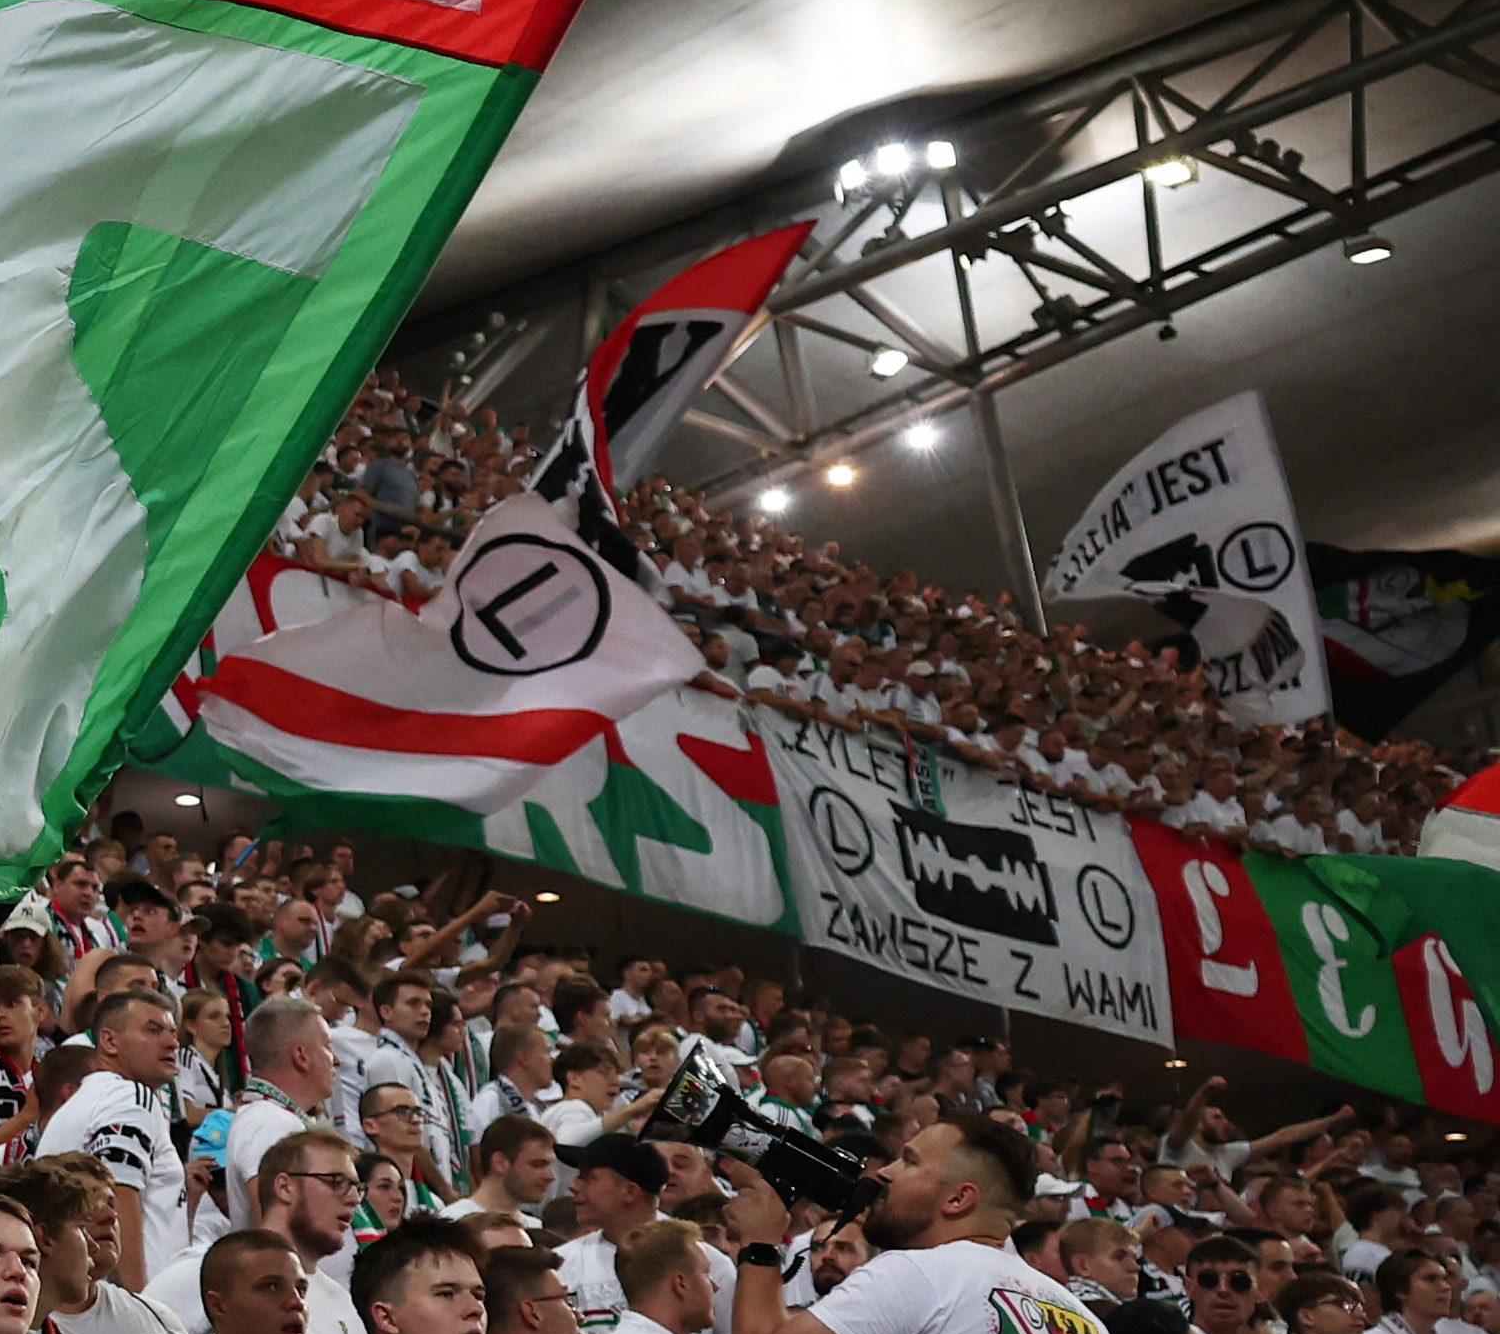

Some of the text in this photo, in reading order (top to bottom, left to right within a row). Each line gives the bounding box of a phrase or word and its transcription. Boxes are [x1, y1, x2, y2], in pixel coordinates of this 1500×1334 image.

[1146, 436, 1232, 516] JEST
[1010, 950, 1041, 1000] Z
[1064, 963, 1158, 1031] WAMI
